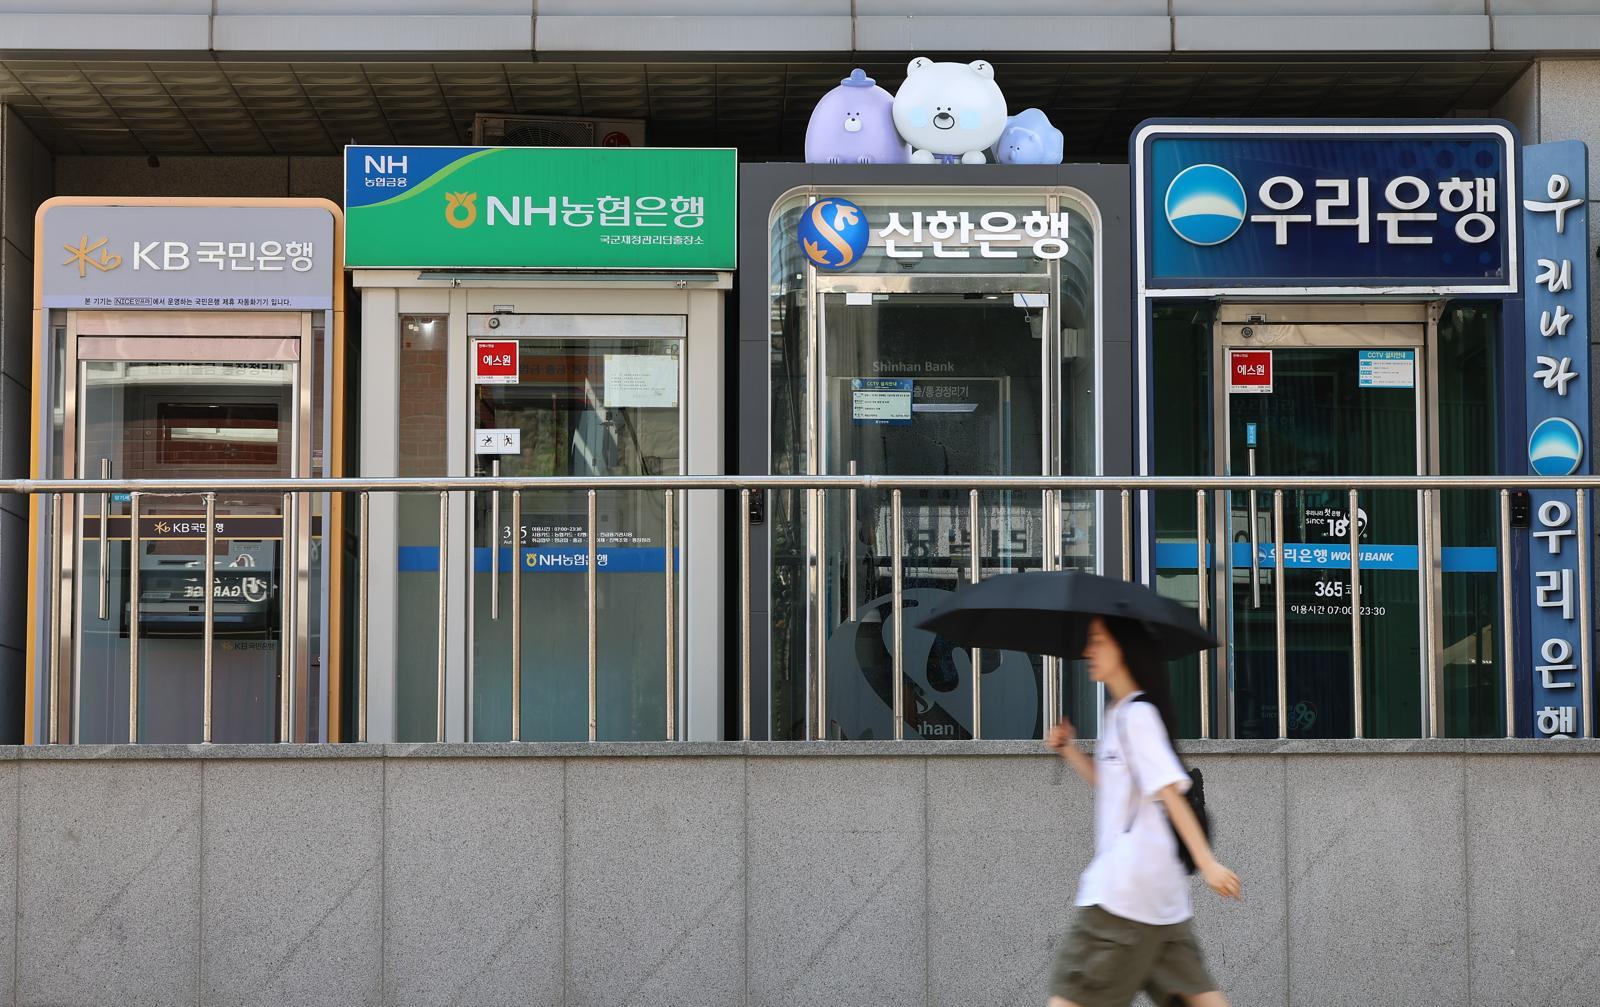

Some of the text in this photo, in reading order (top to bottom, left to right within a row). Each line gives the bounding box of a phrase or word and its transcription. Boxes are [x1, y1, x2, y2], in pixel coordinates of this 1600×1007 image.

[365, 155, 408, 174] NH
[365, 177, 408, 188] 농협금융
[486, 195, 705, 229] NH농협은행
[1250, 175, 1497, 246] 우리은행
[879, 210, 1069, 260] 신한은행
[1523, 174, 1585, 396] 우리나라
[194, 297, 220, 306] 국민은행
[482, 354, 511, 367] 에스원
[872, 360, 955, 372] Shinhan Bank
[1236, 364, 1266, 376] 에스원
[173, 522, 225, 533] KB국민행
[503, 525, 527, 539] 35
[1365, 552, 1394, 562] BANK
[1314, 581, 1343, 598] 365
[1291, 604, 1325, 616] 이용시간
